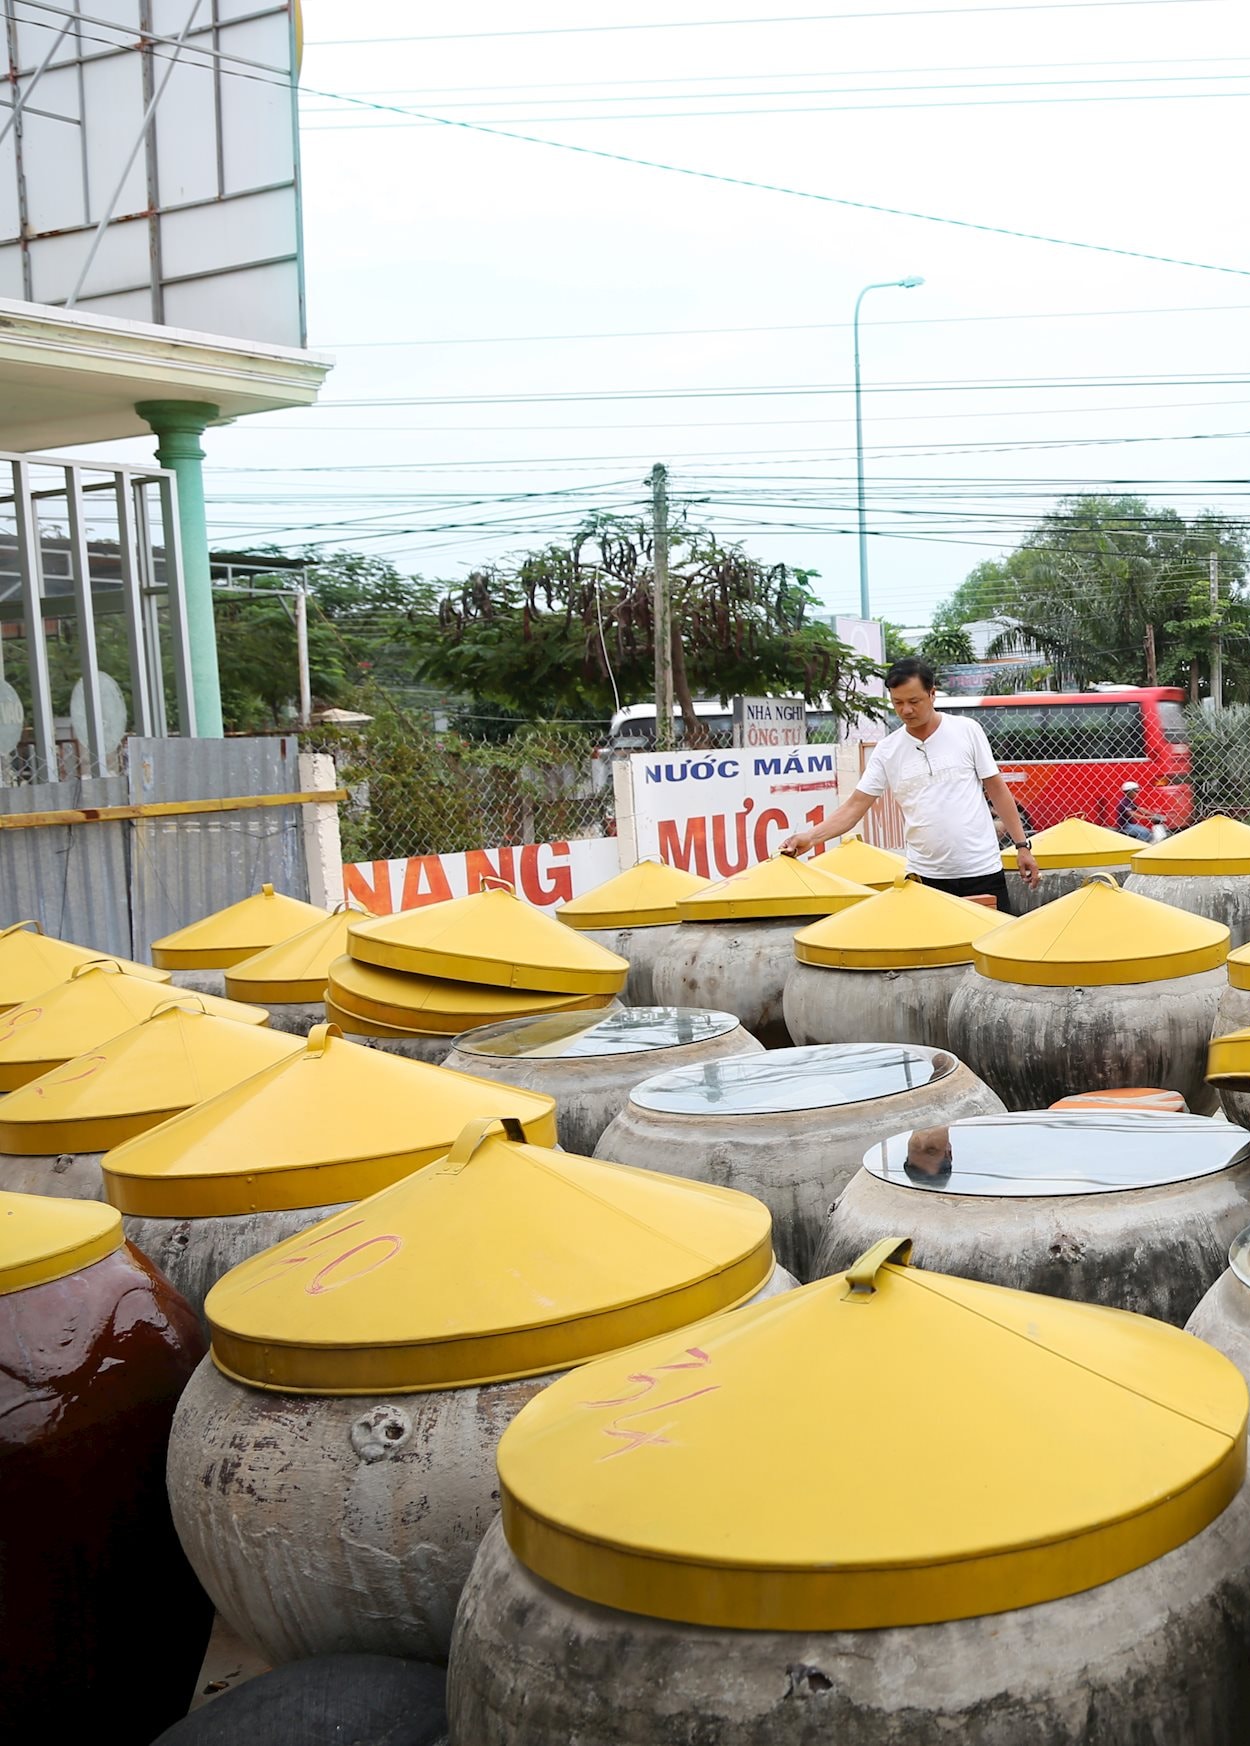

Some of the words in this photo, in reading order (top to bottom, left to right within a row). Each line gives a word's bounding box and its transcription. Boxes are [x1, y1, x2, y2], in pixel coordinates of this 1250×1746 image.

[747, 701, 772, 721] NHÀ
[747, 723, 779, 746] ÔNG
[645, 754, 740, 784] NƯỚC
[754, 749, 833, 776] MẮM
